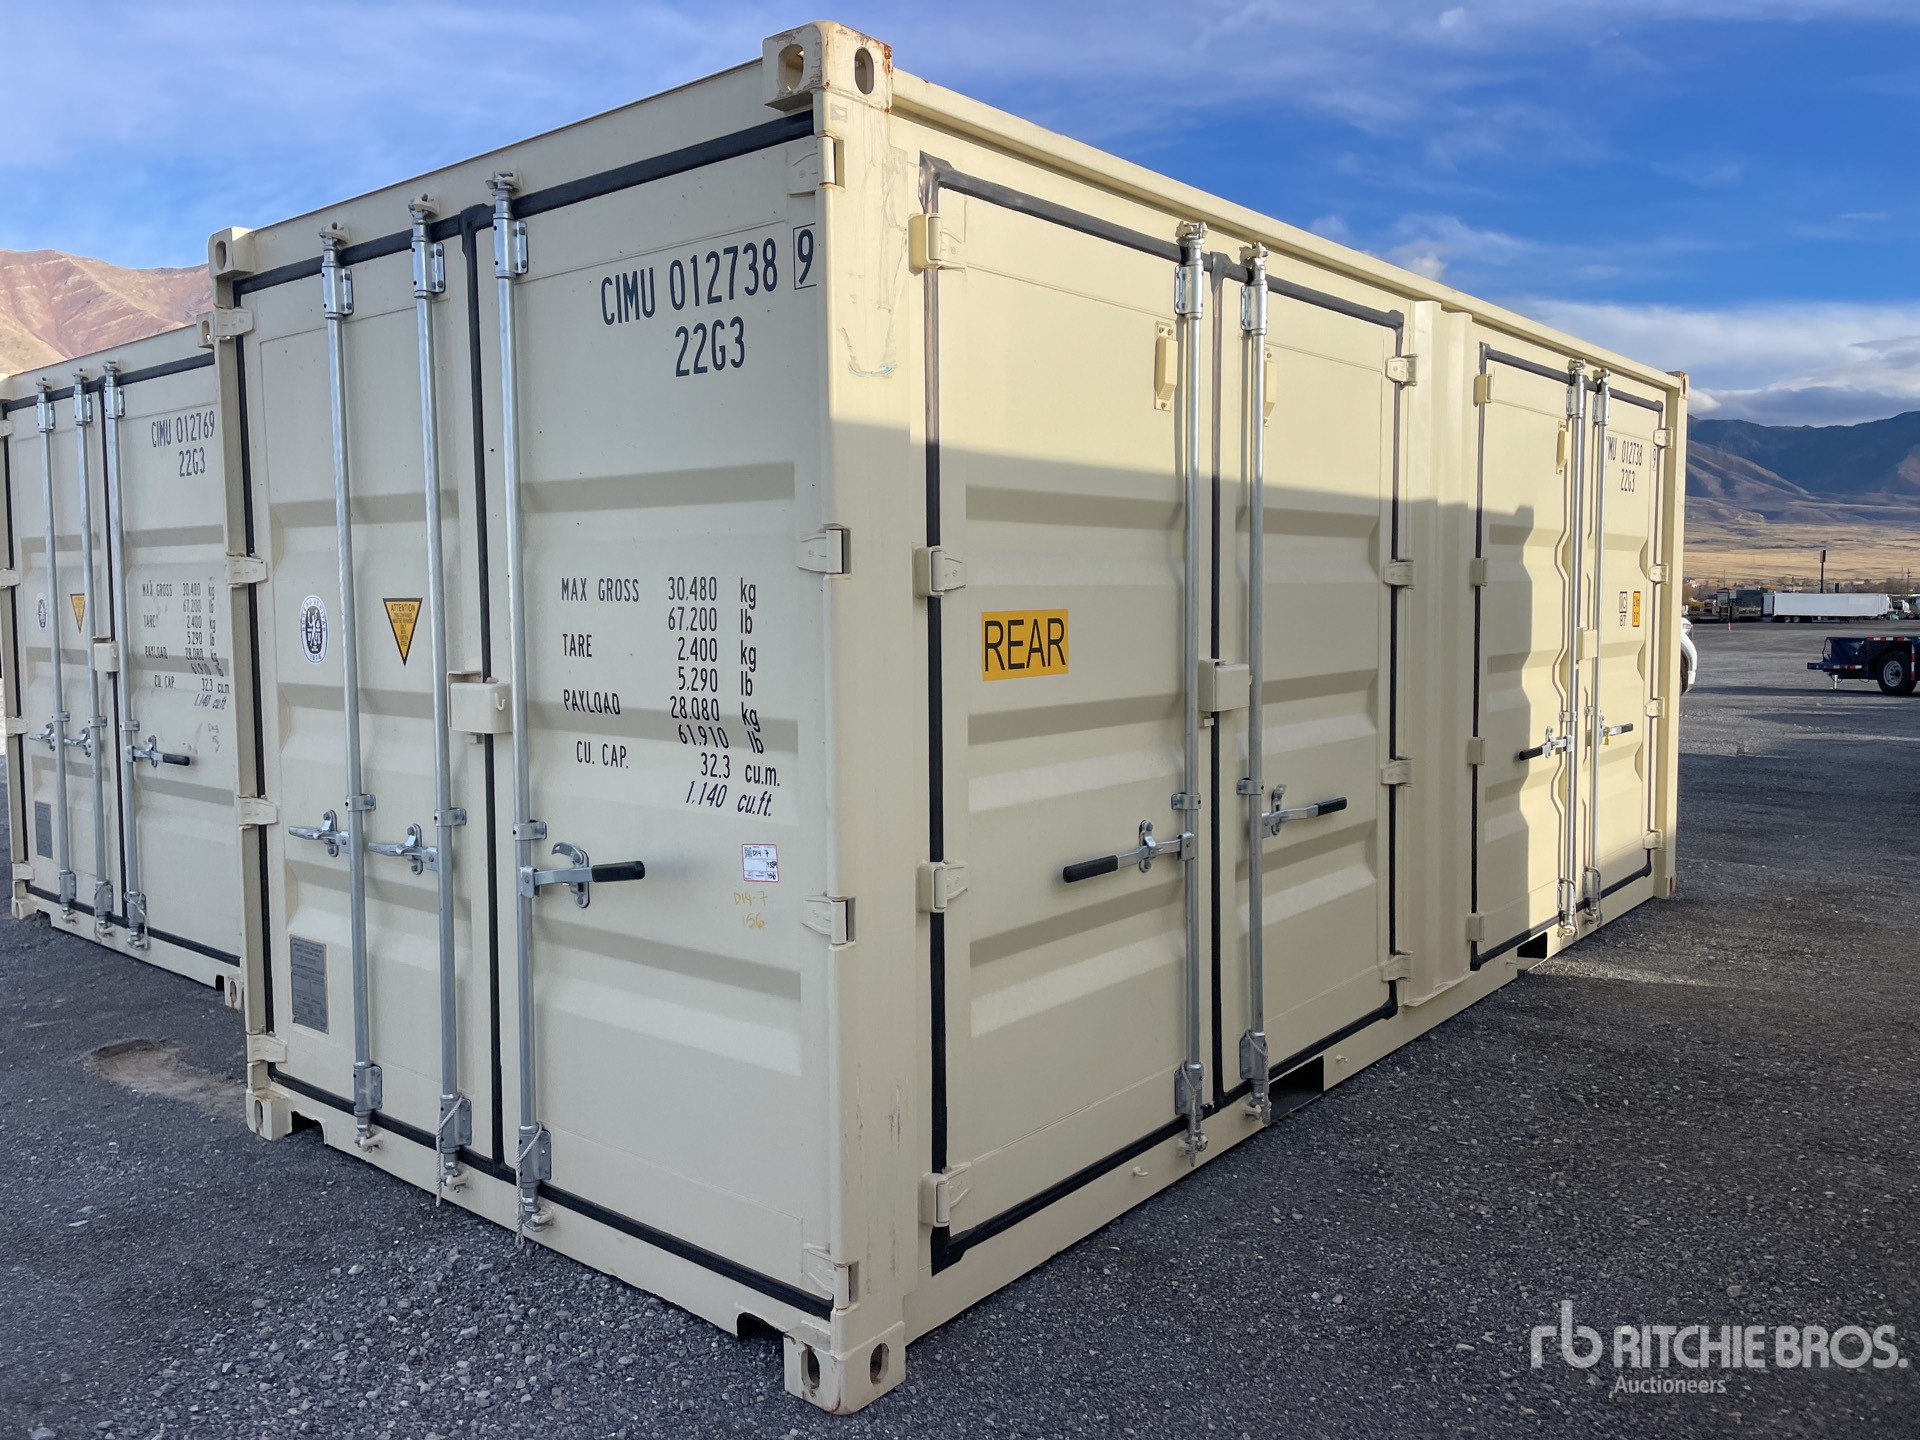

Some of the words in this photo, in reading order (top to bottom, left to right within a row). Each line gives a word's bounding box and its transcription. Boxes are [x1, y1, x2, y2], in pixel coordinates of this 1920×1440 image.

[601, 267, 656, 325] CIMU
[669, 238, 778, 311] 012738
[798, 229, 814, 285] 9
[675, 316, 745, 378] 22G3
[151, 419, 172, 448] CIMU
[176, 410, 215, 443] 012769
[179, 447, 206, 477] 22G3
[561, 577, 588, 601] MAX
[598, 578, 640, 602] GROSS
[740, 577, 757, 610] kg
[740, 609, 753, 634] lb
[562, 633, 593, 657] TARE
[740, 639, 757, 672] kg
[984, 617, 1066, 672] REAR
[740, 670, 753, 697] lb
[563, 689, 621, 715] PAYLOAD
[741, 701, 761, 733] kg
[747, 730, 764, 755] lb
[576, 740, 595, 765] CU.
[602, 743, 629, 769] CAP.
[700, 752, 731, 779] 32.3
[745, 764, 781, 787] cu.m.
[737, 790, 772, 817] cu.ft.
